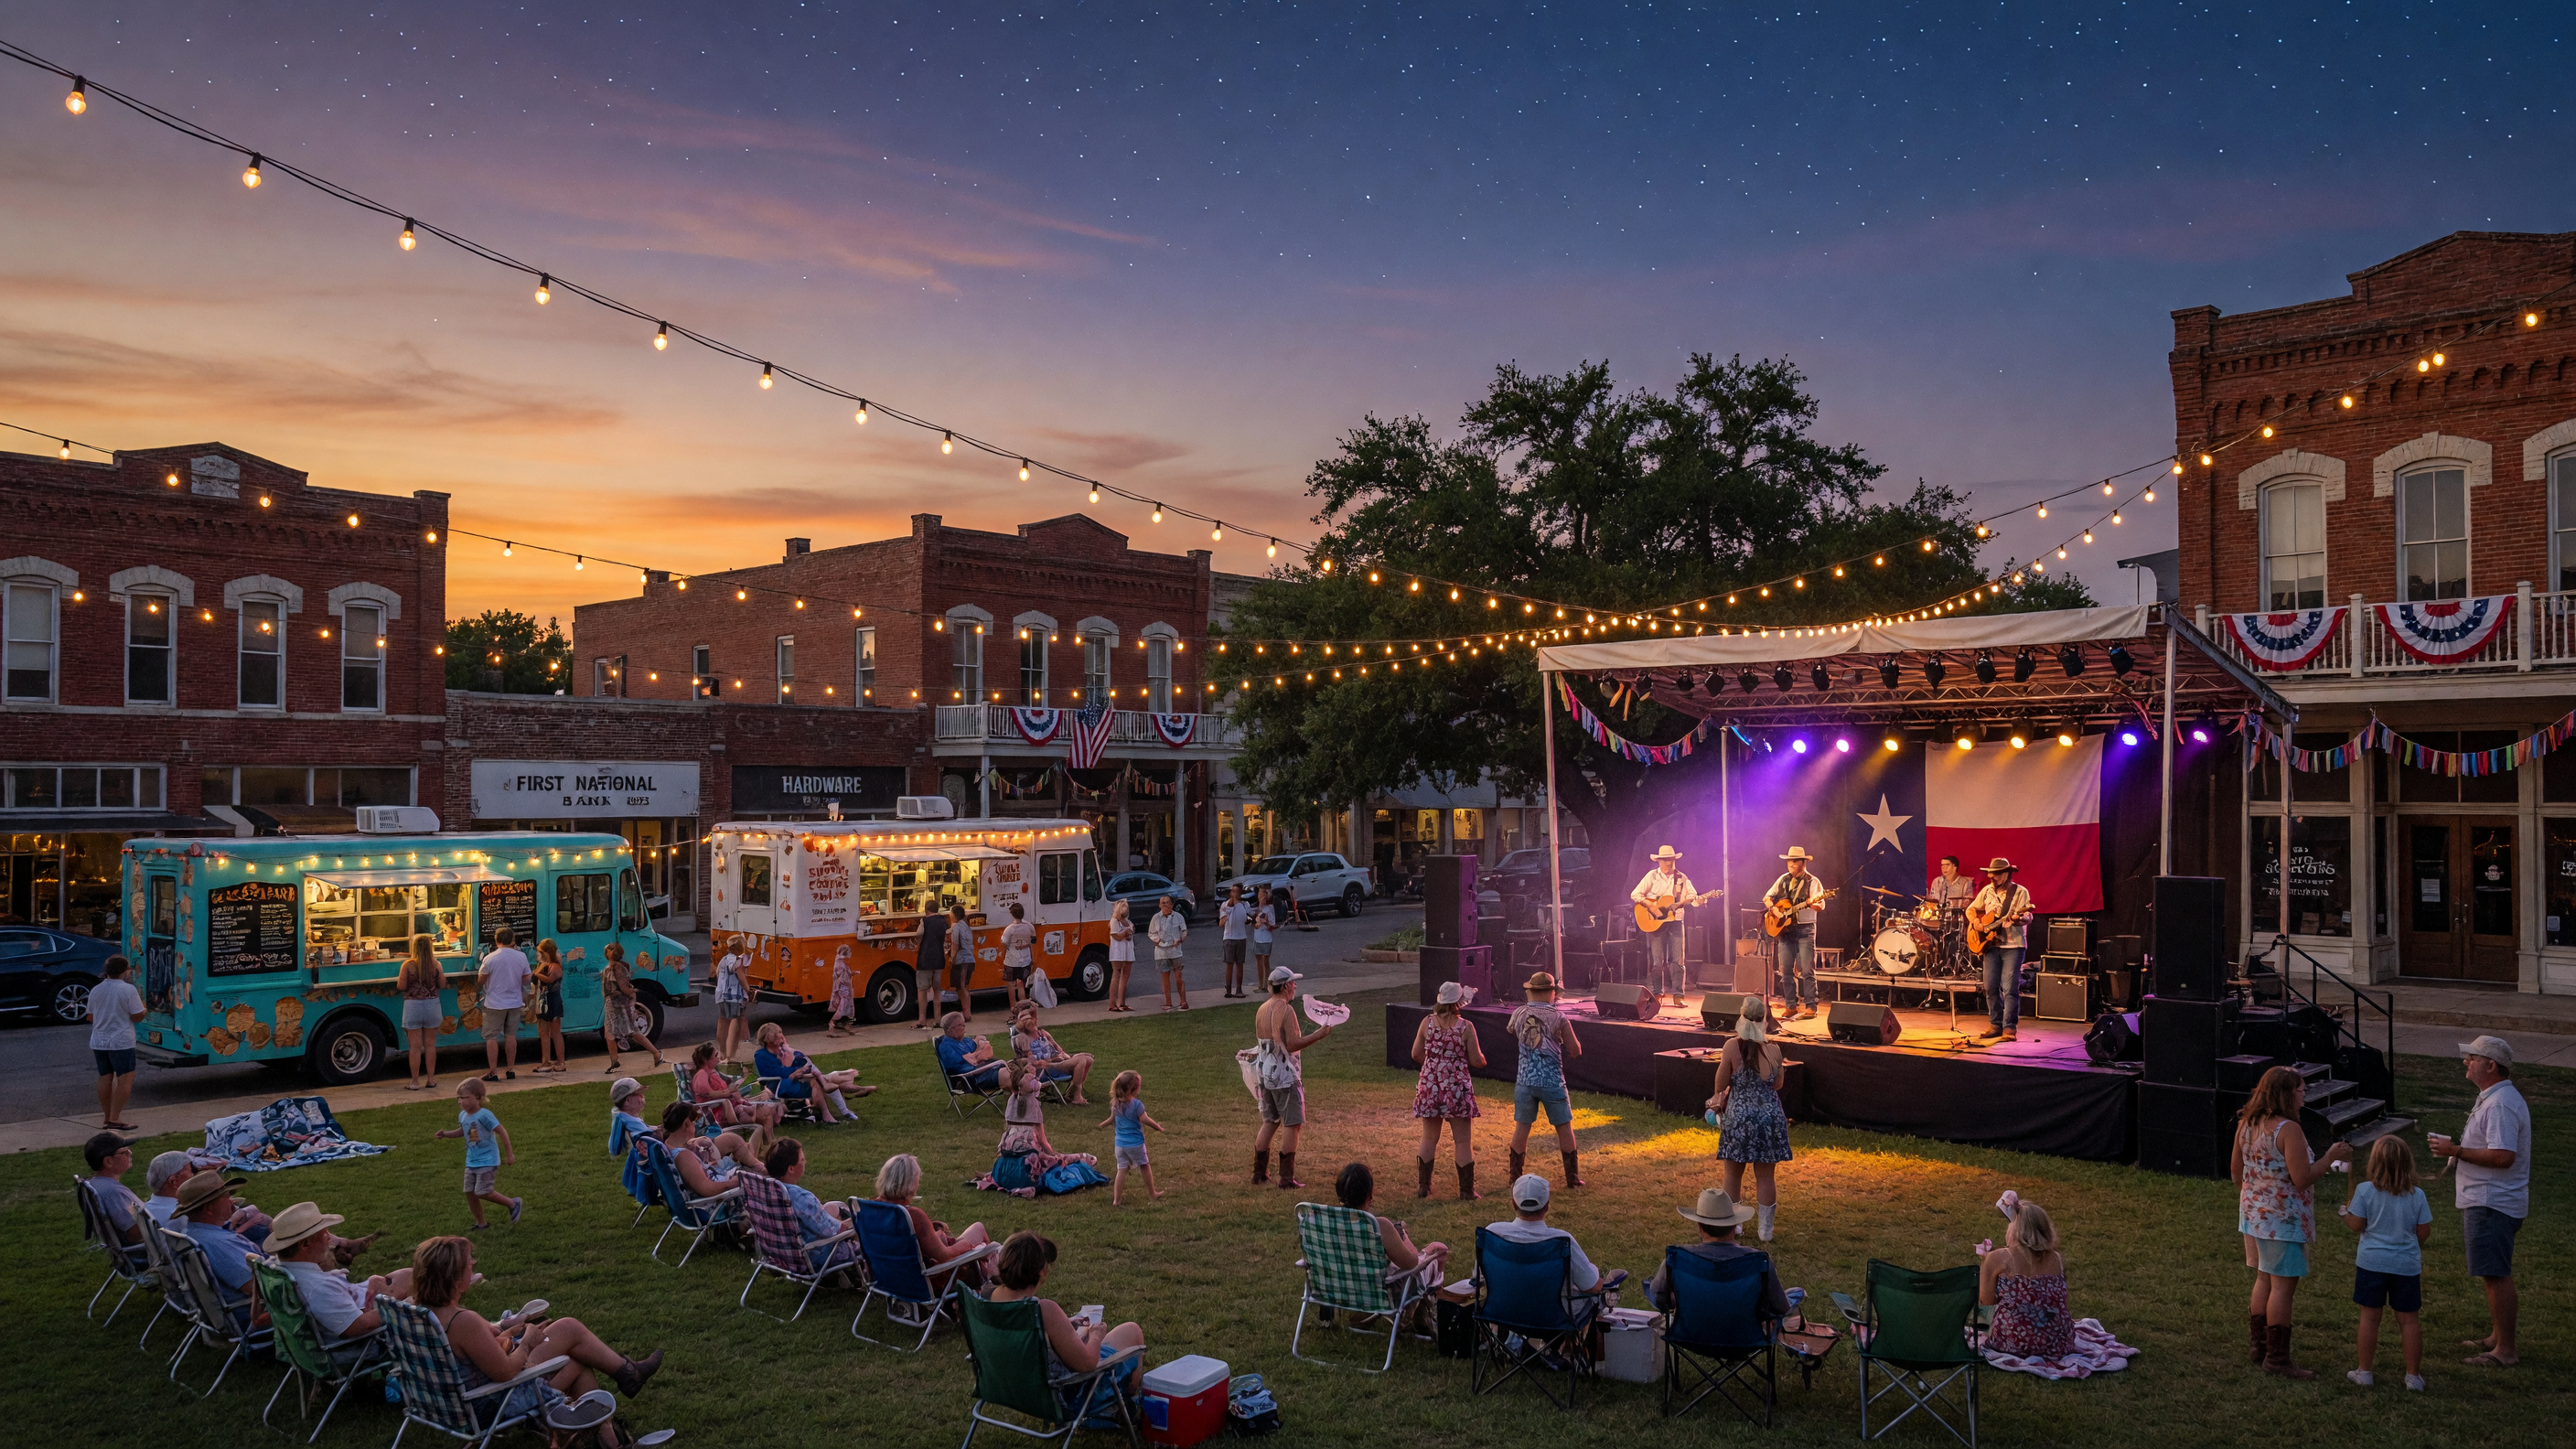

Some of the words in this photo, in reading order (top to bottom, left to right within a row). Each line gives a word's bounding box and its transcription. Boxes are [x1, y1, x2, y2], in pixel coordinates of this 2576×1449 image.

[517, 775, 565, 791] FIRST
[575, 775, 658, 791] NATIONAL
[782, 776, 862, 794] HARDWARE
[563, 796, 611, 806] BANK
